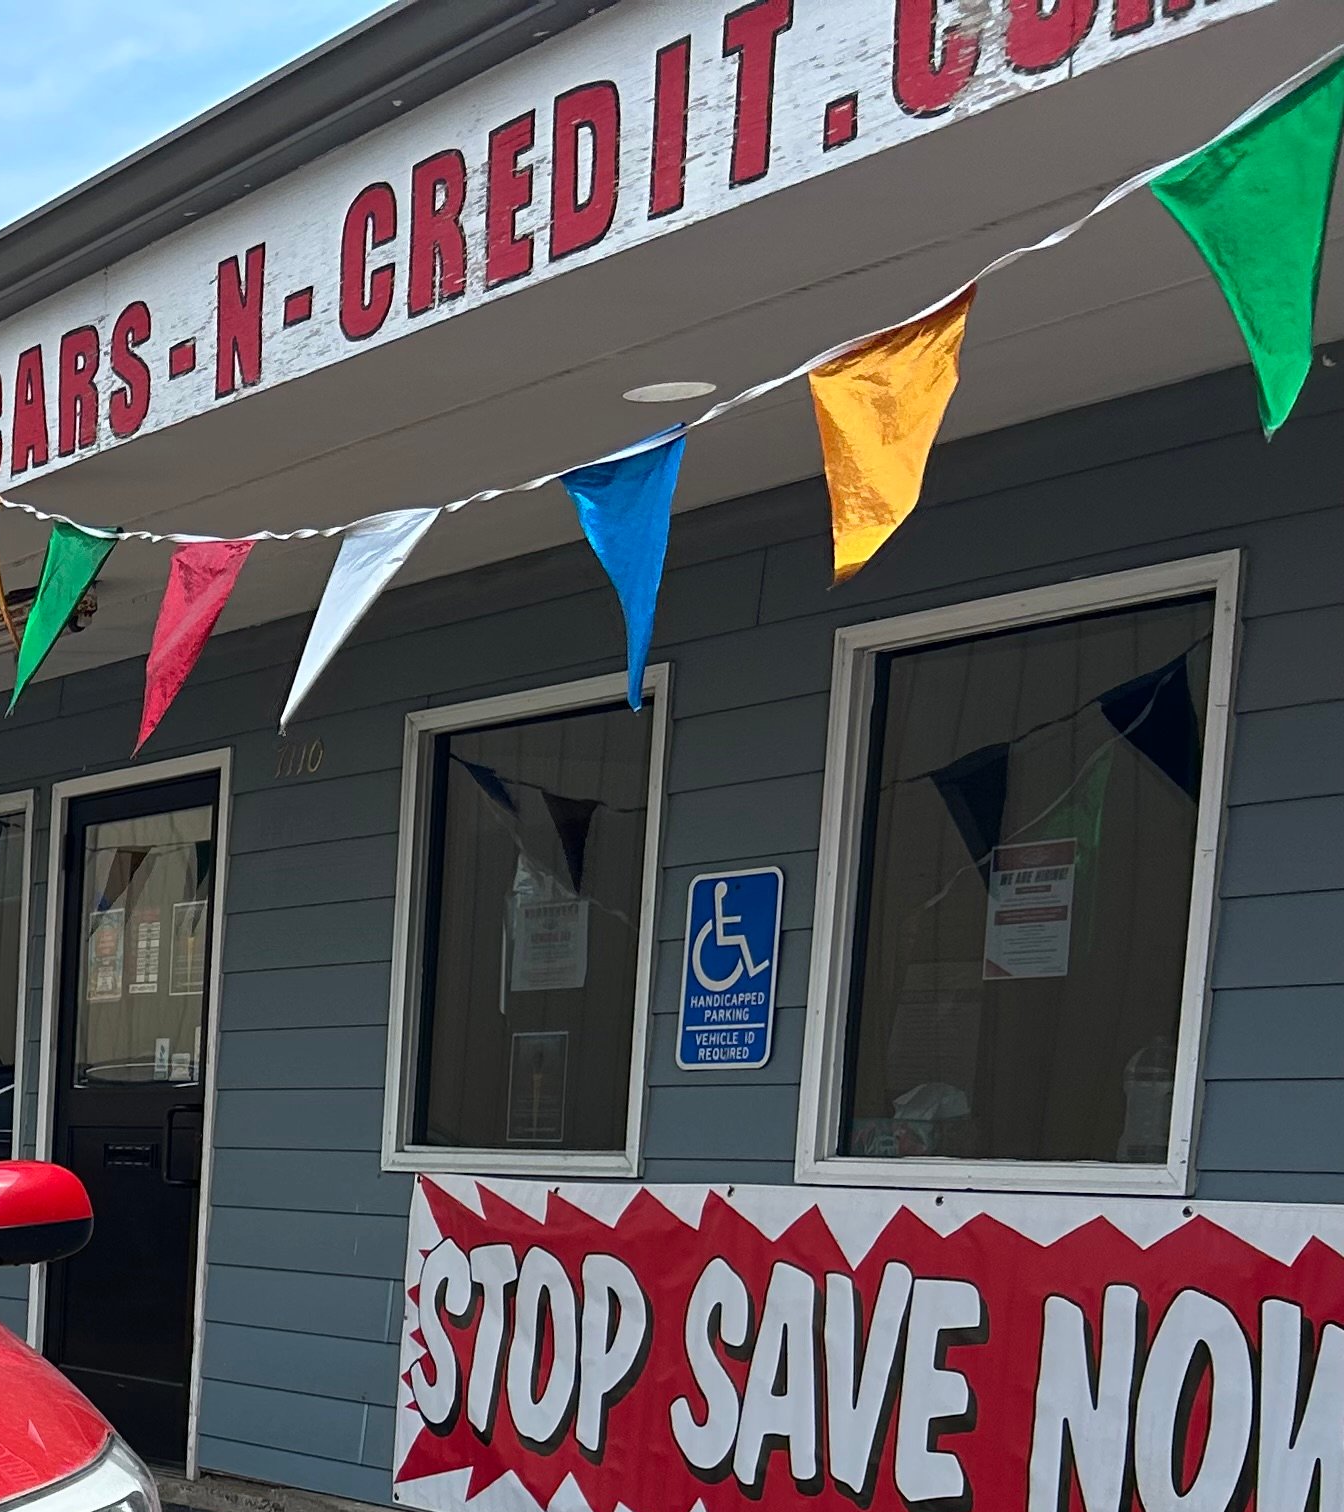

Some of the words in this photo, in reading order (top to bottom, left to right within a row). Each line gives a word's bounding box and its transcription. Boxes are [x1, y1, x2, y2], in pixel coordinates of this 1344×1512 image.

[690, 991, 765, 1009] HANDICAPPED
[704, 1008, 749, 1022] PARKING
[695, 1032, 739, 1046] VEHICLE
[744, 1031, 755, 1045] ID
[698, 1046, 749, 1061] REQUIRED
[409, 1237, 653, 1462] STOP
